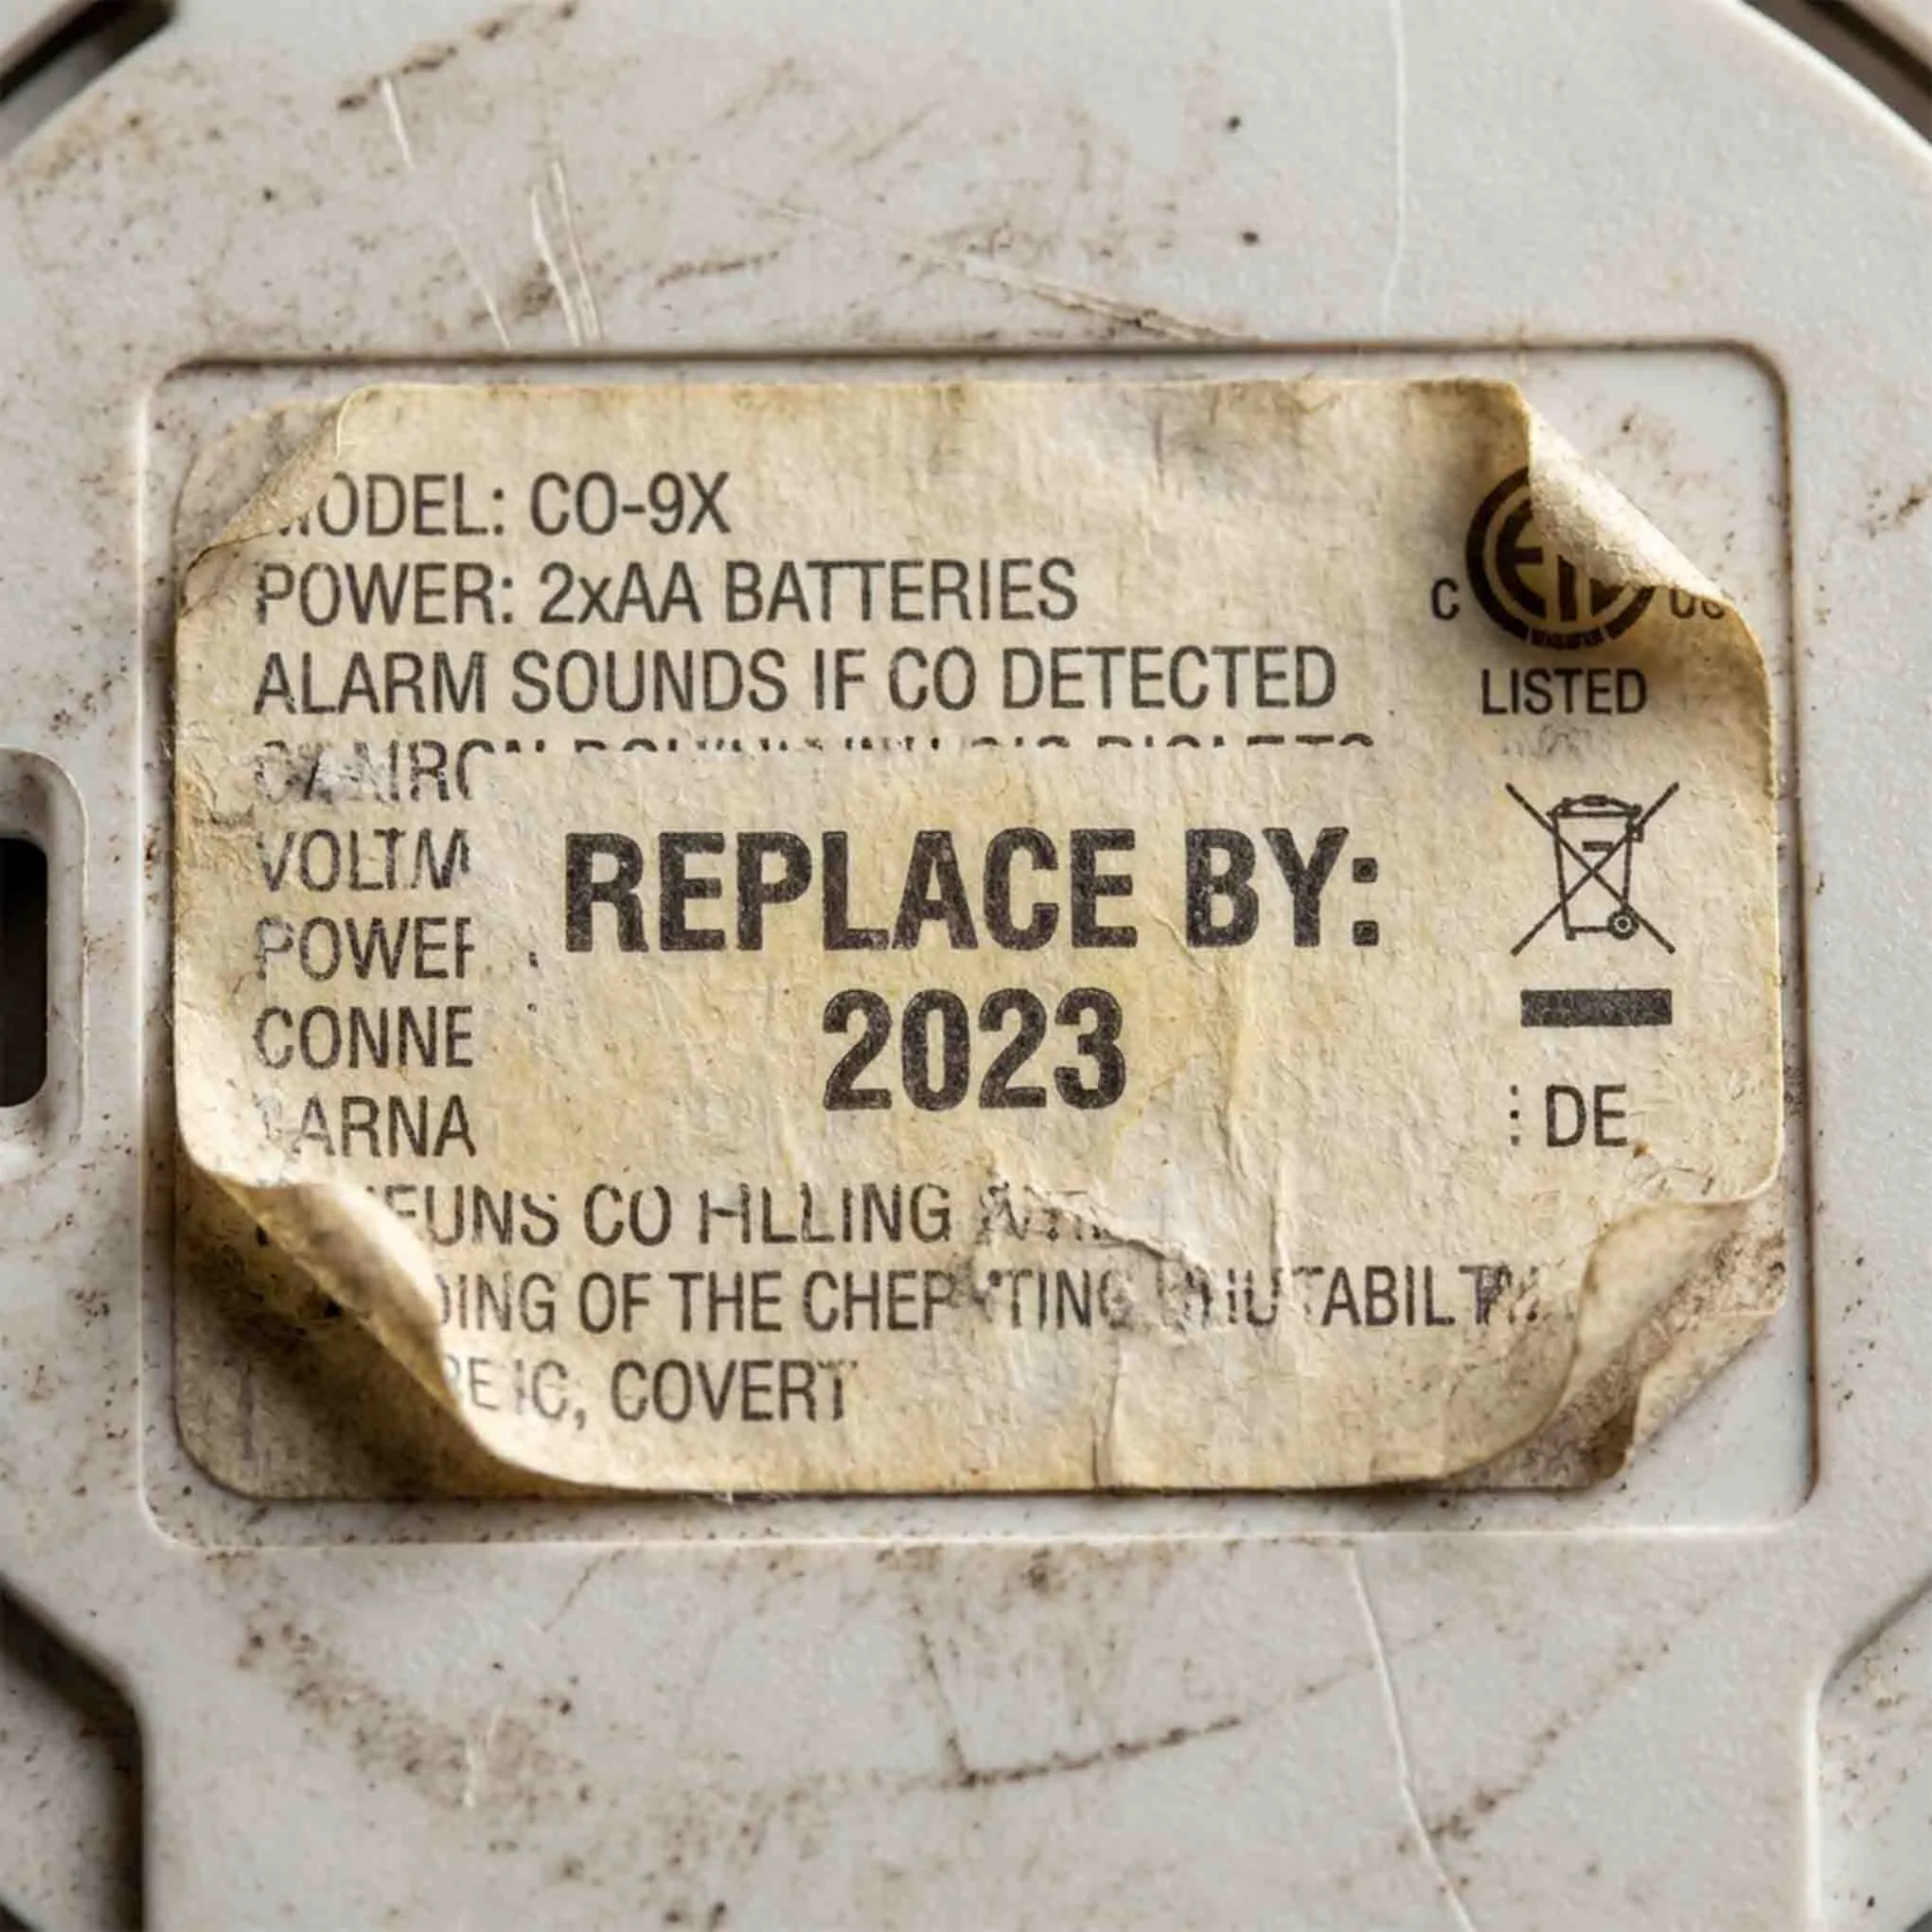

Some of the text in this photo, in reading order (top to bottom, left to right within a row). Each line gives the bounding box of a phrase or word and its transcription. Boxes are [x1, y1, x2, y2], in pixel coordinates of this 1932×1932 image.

[277, 471, 732, 536] ODEL: CO-9X
[256, 557, 1078, 626] POWER: 2xAA BATTERIES
[254, 645, 1336, 715] ALARM SOUNDS IF CO DETECTED
[1481, 668, 1647, 715] LISTED
[565, 826, 1378, 952] REPLACE BY:
[822, 987, 1126, 1111] 2023
[254, 1093, 476, 1157] ARNA
[1546, 1084, 1627, 1147] DE
[583, 1183, 672, 1246] CO
[578, 1271, 651, 1333] OF
[667, 1270, 783, 1332] THE
